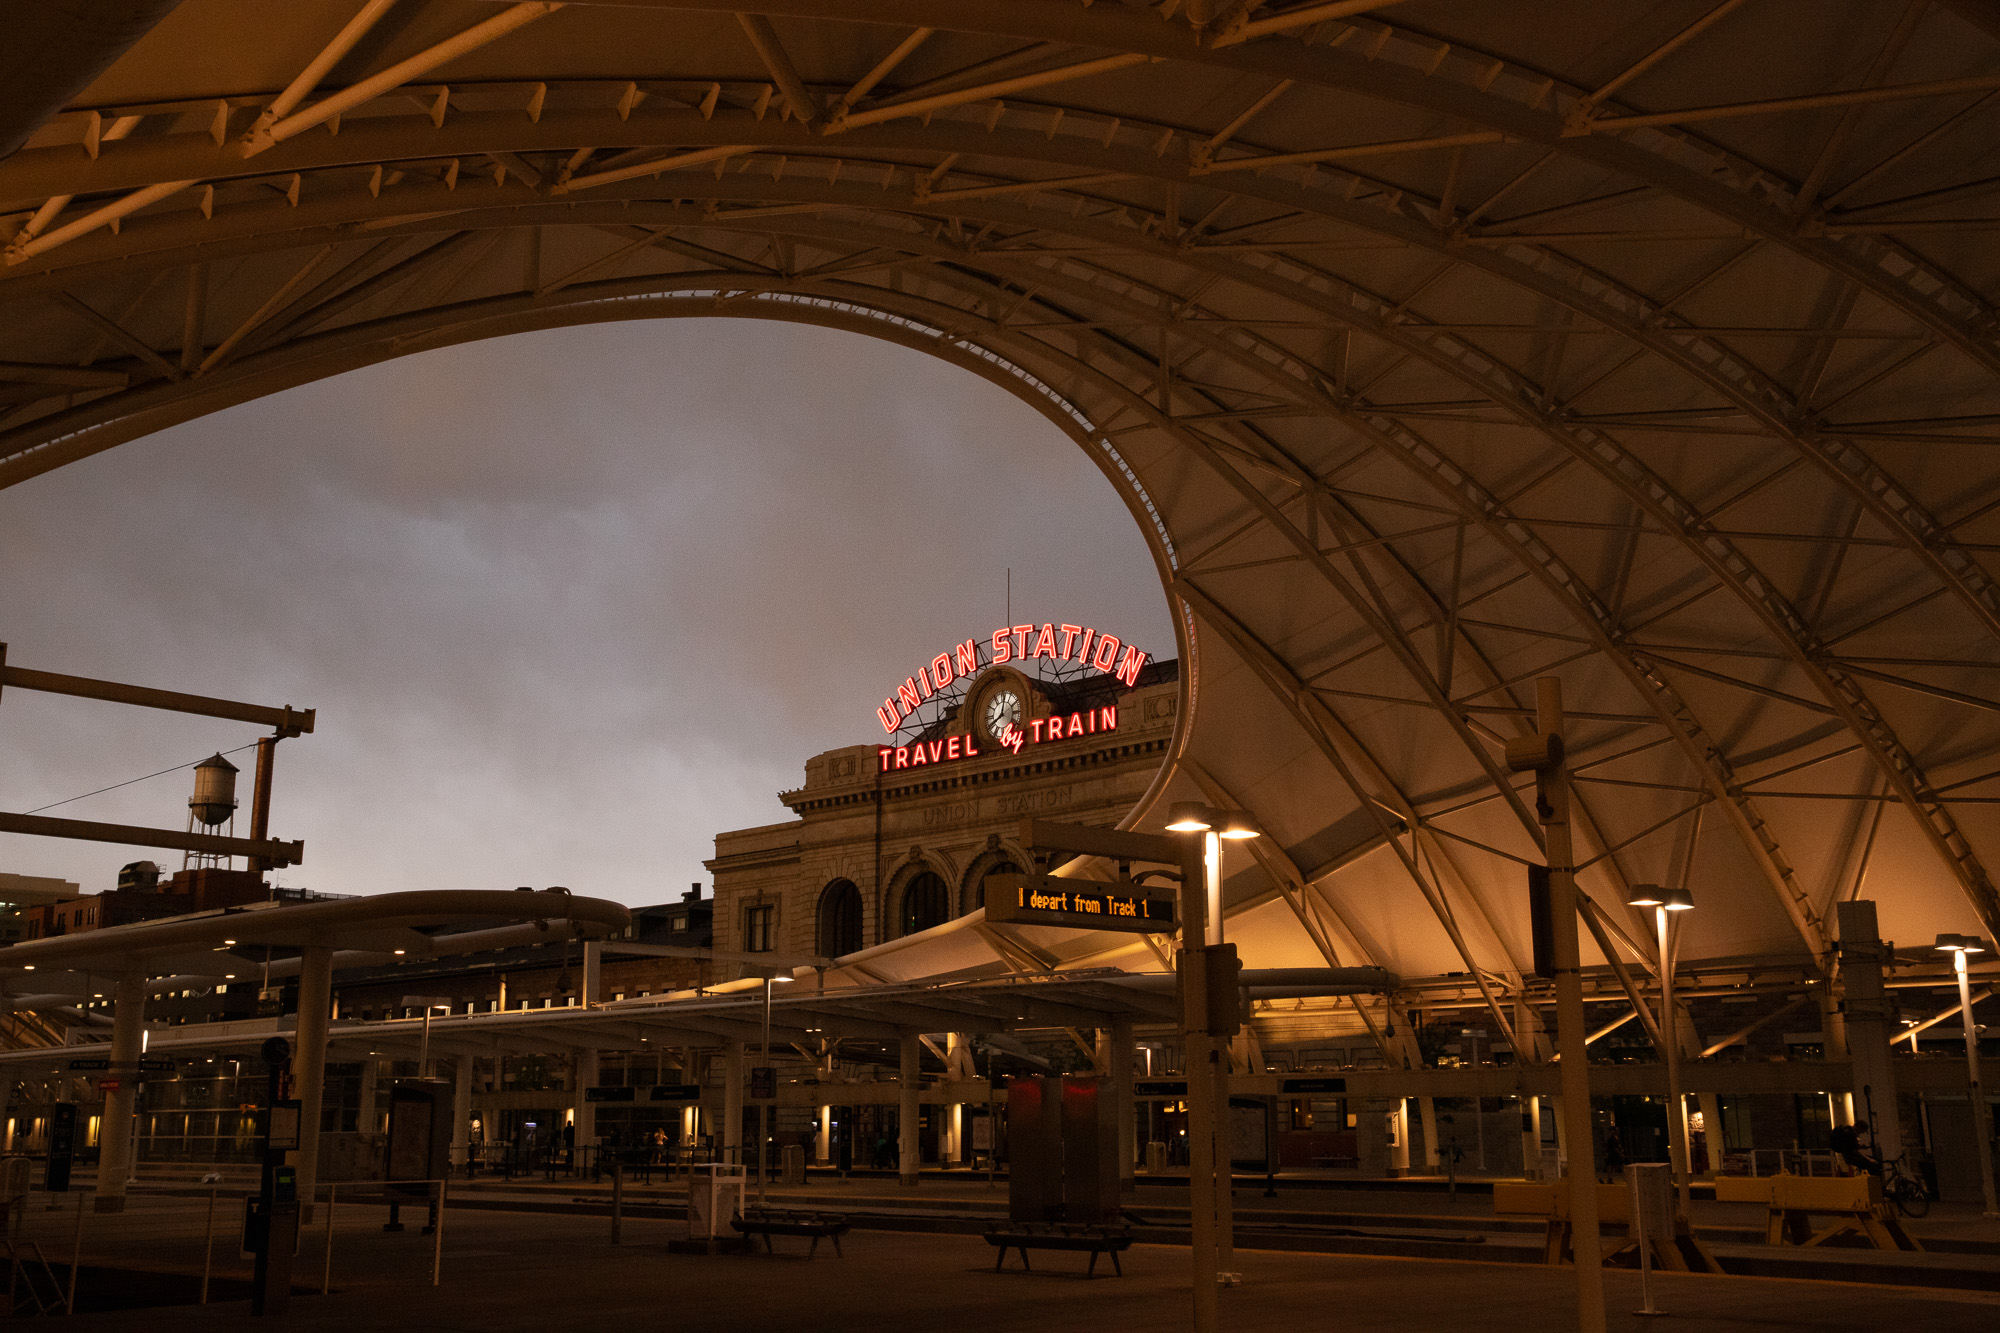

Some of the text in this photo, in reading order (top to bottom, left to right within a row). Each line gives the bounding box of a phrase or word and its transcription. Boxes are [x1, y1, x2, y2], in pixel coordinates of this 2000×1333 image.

[876, 623, 1147, 734] UNION STATION
[879, 706, 1117, 772] TRAVEL by TRAIN
[924, 786, 1073, 825] UNION STATION
[1030, 889, 1068, 911] depart
[1073, 893, 1101, 914] from
[1106, 895, 1137, 917] Track
